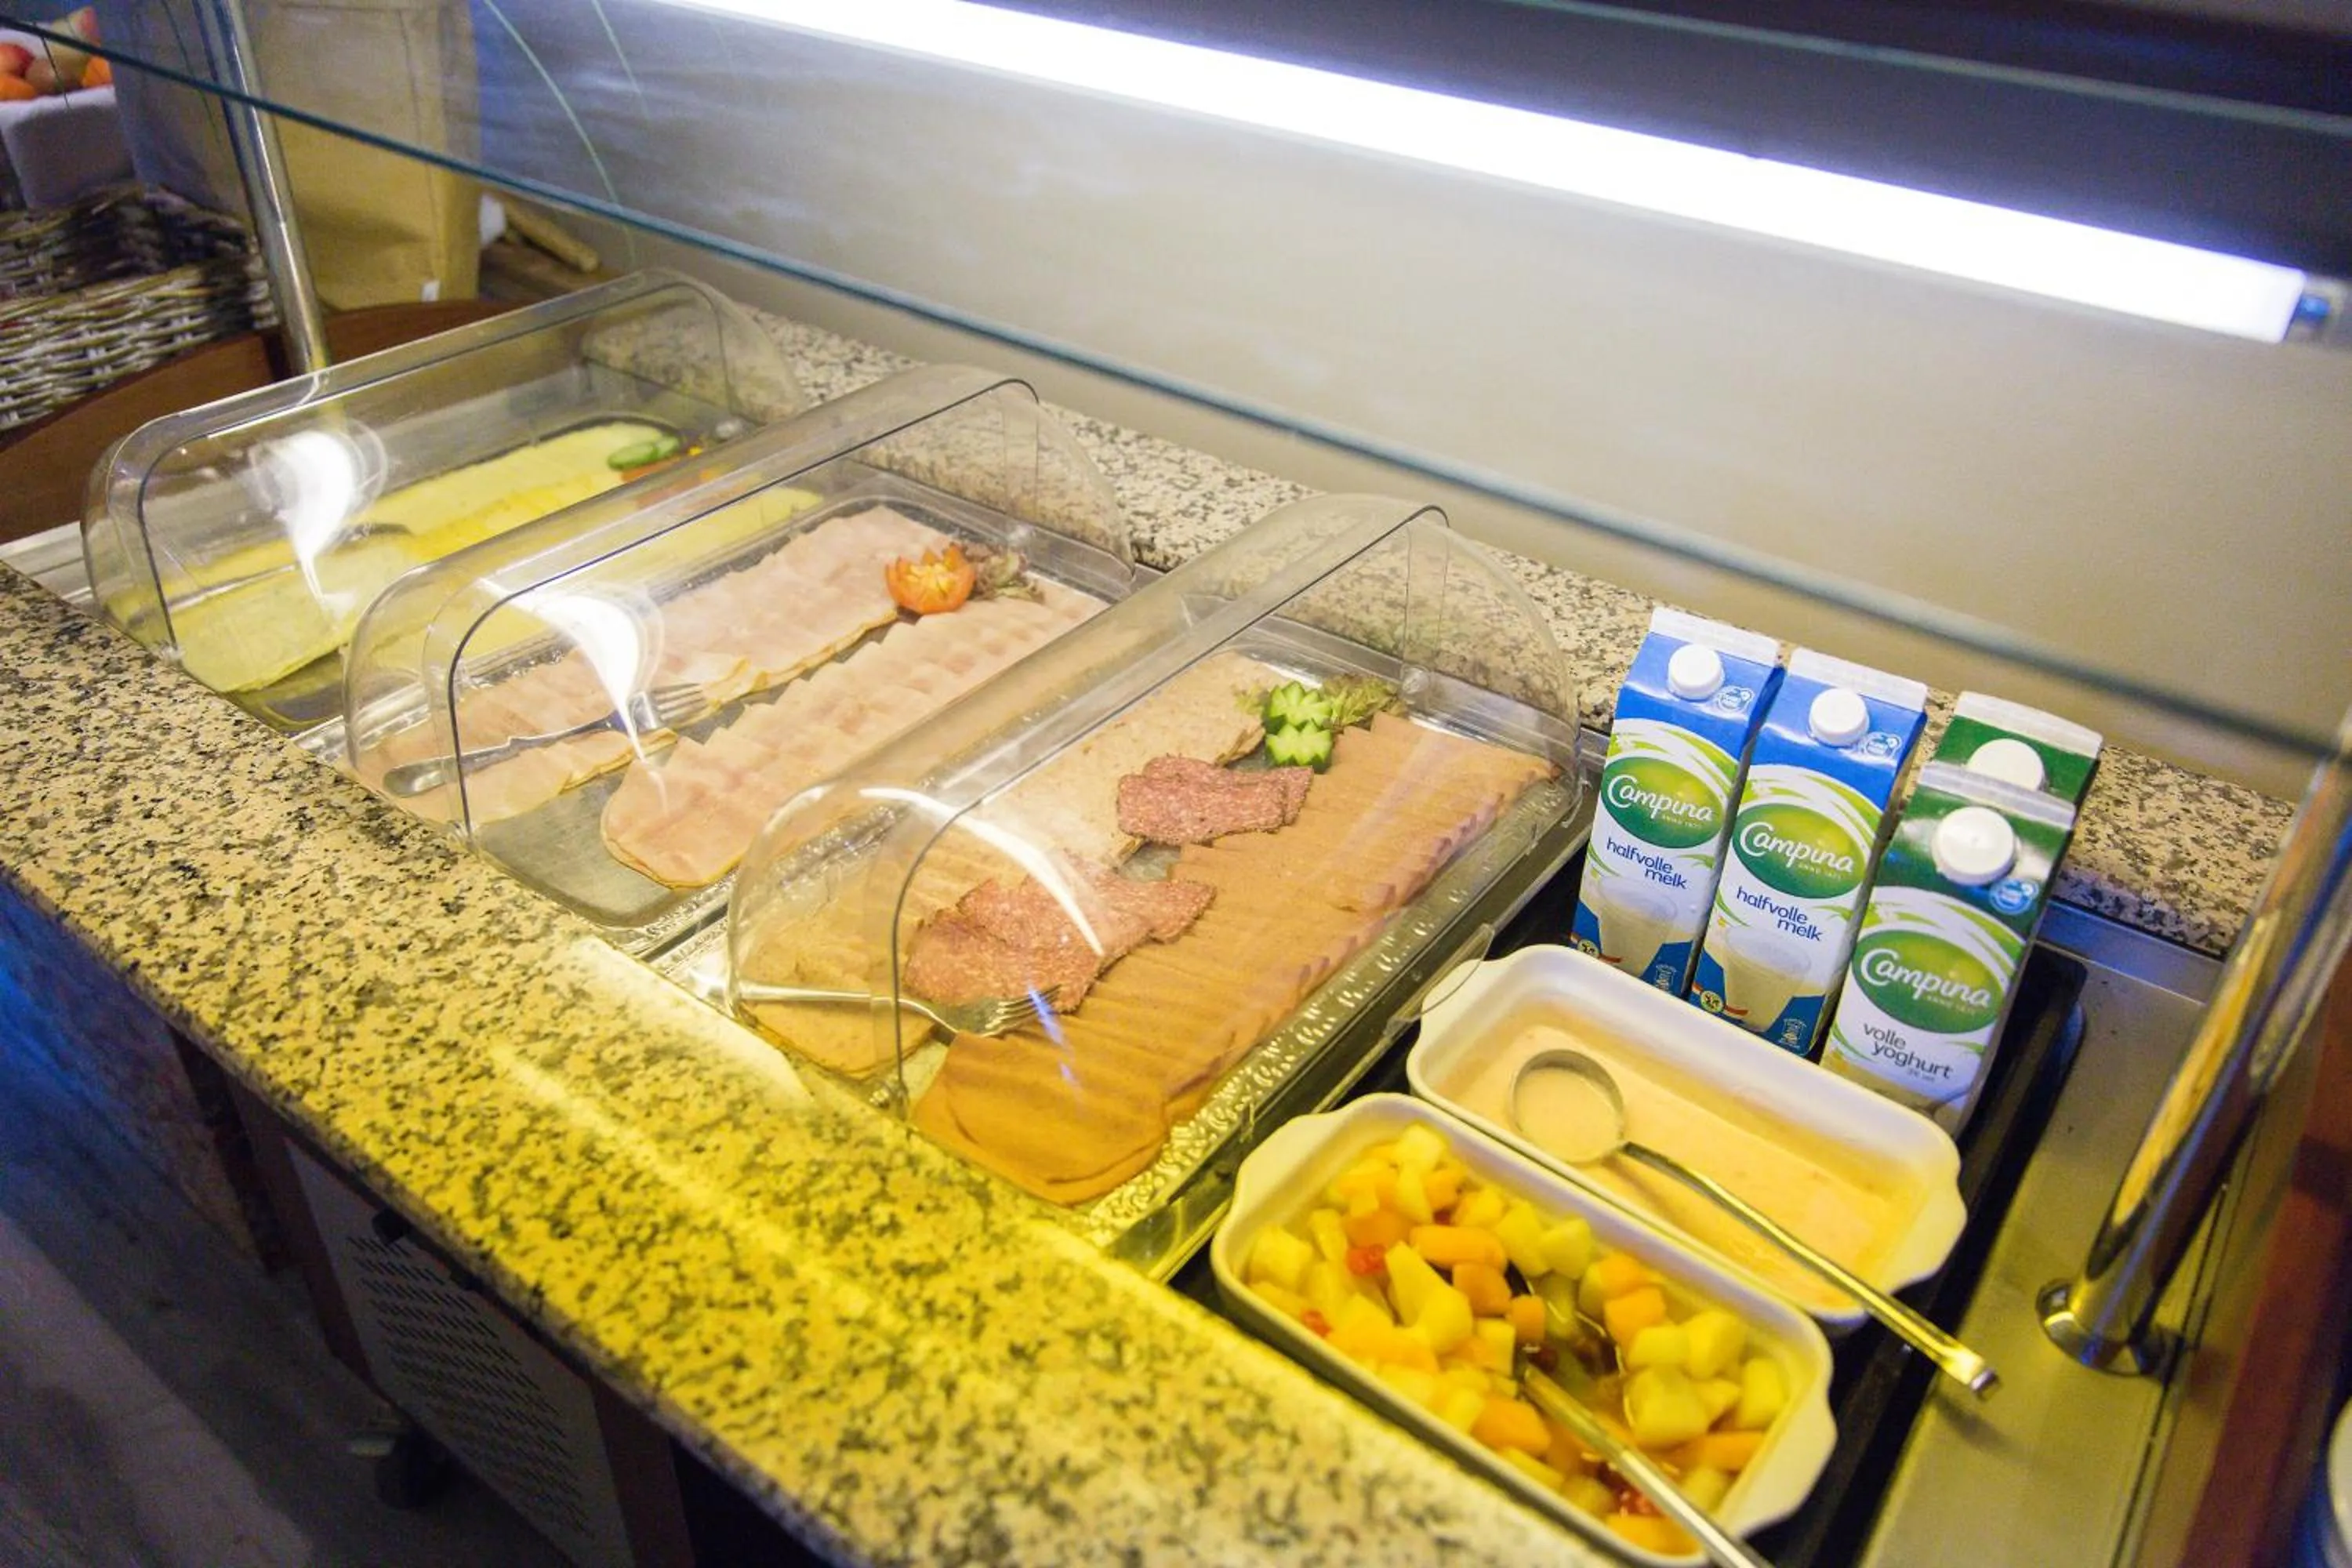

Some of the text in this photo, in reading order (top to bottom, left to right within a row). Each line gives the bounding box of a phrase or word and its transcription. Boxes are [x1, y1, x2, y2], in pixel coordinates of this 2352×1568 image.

[1608, 774, 1714, 821] Campina
[1606, 837, 1673, 874] halfvolle
[1740, 822, 1853, 873] Campina
[1645, 868, 1688, 890] melk
[1737, 886, 1808, 924] halfvolle
[1777, 918, 1824, 941] melk
[1860, 949, 1991, 1007] Campina
[1863, 1023, 1907, 1049] volle
[1871, 1041, 1954, 1080] yoghurt
